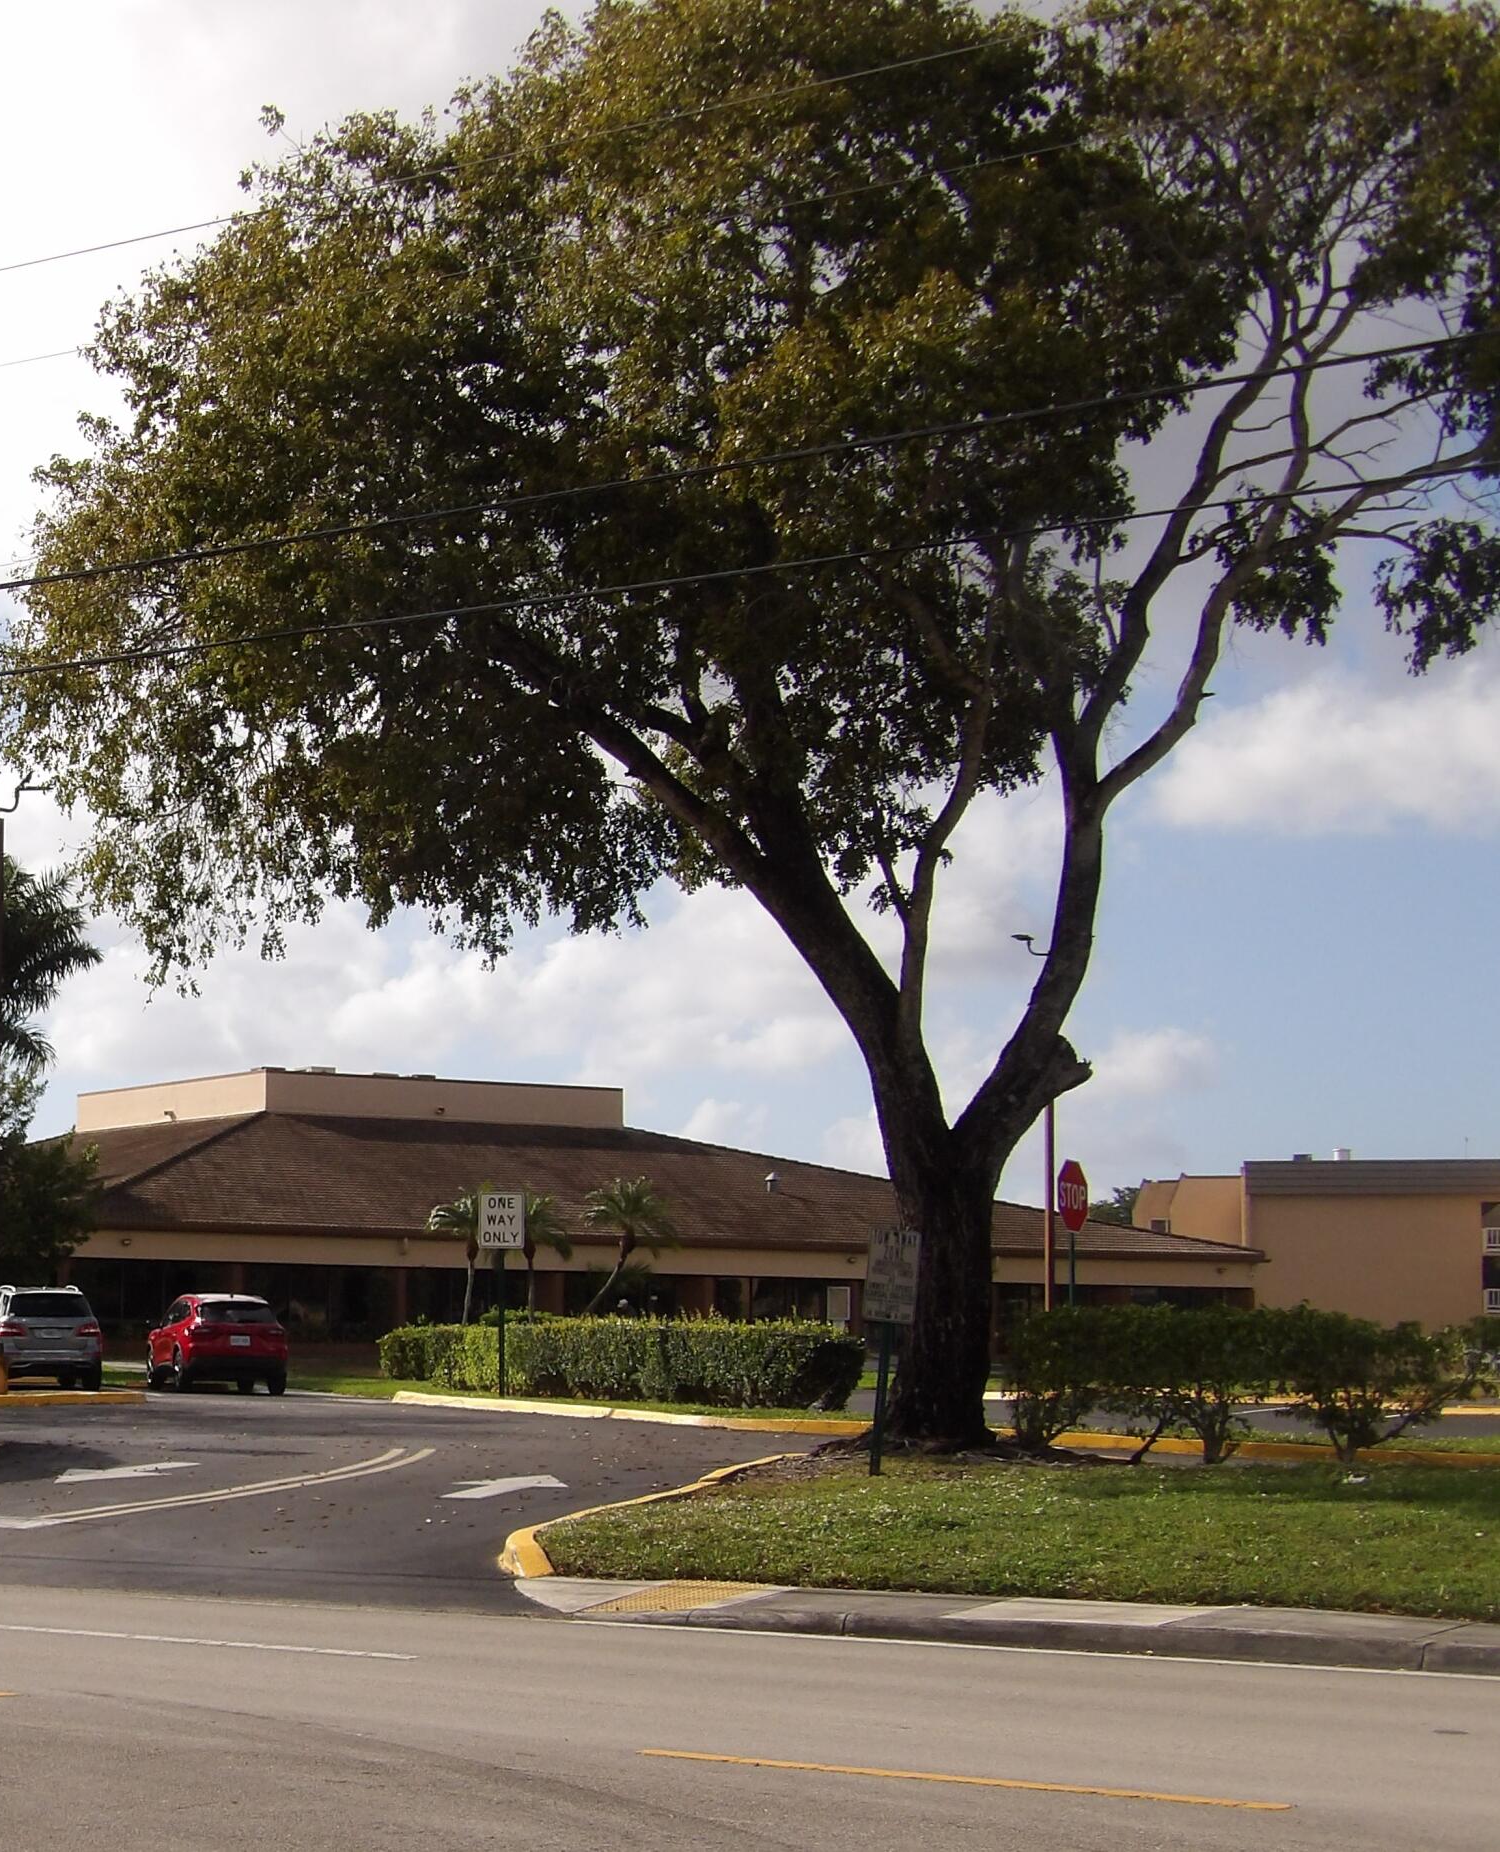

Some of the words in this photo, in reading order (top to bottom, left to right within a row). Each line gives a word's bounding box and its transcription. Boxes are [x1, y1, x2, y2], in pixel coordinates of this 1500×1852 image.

[1059, 1181, 1086, 1211] STOP
[488, 1197, 515, 1209] ONE
[486, 1214, 516, 1227] WAY
[483, 1231, 520, 1243] ONLY
